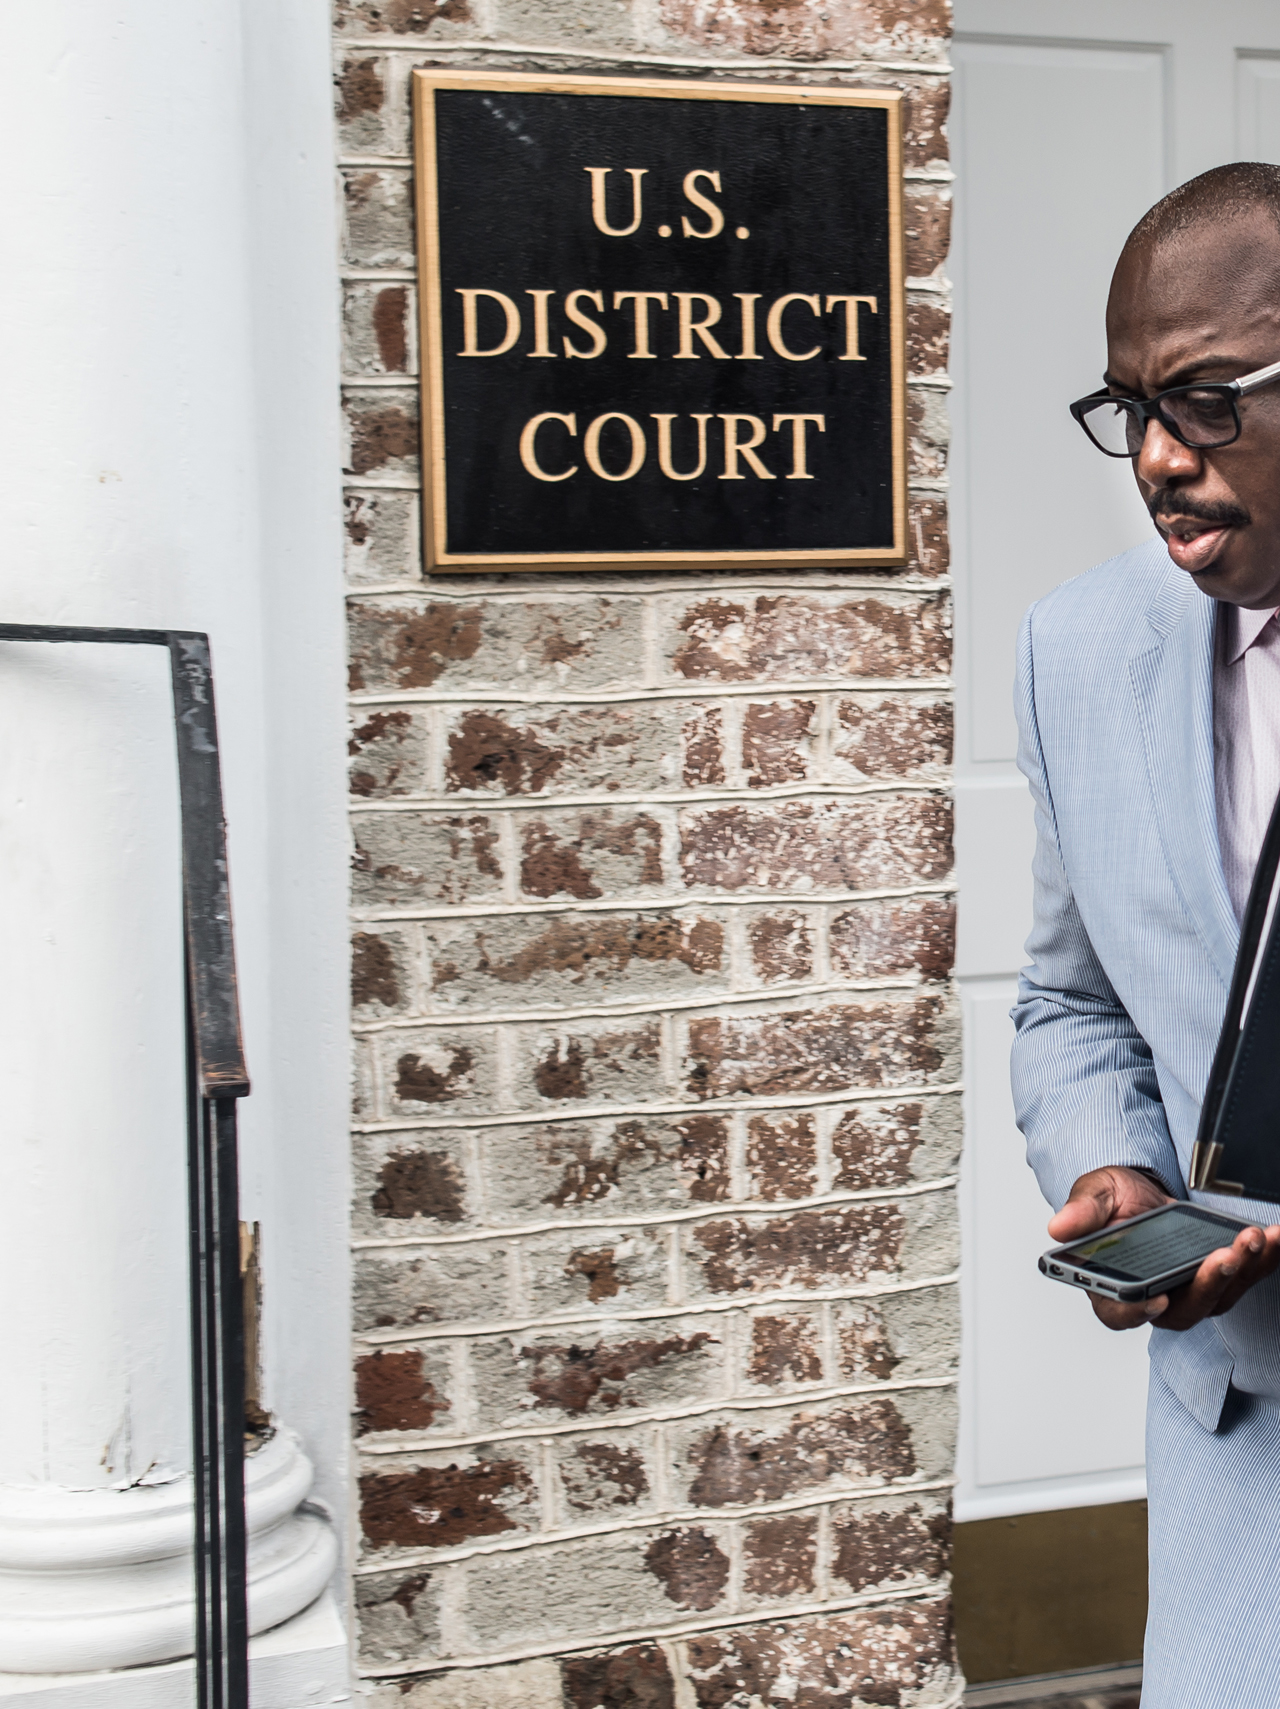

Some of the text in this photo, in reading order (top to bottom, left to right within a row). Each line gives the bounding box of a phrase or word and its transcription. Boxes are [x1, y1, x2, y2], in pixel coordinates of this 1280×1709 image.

[583, 166, 751, 240] U.S.
[454, 287, 878, 362] DISTRICT
[518, 410, 827, 483] COURT
